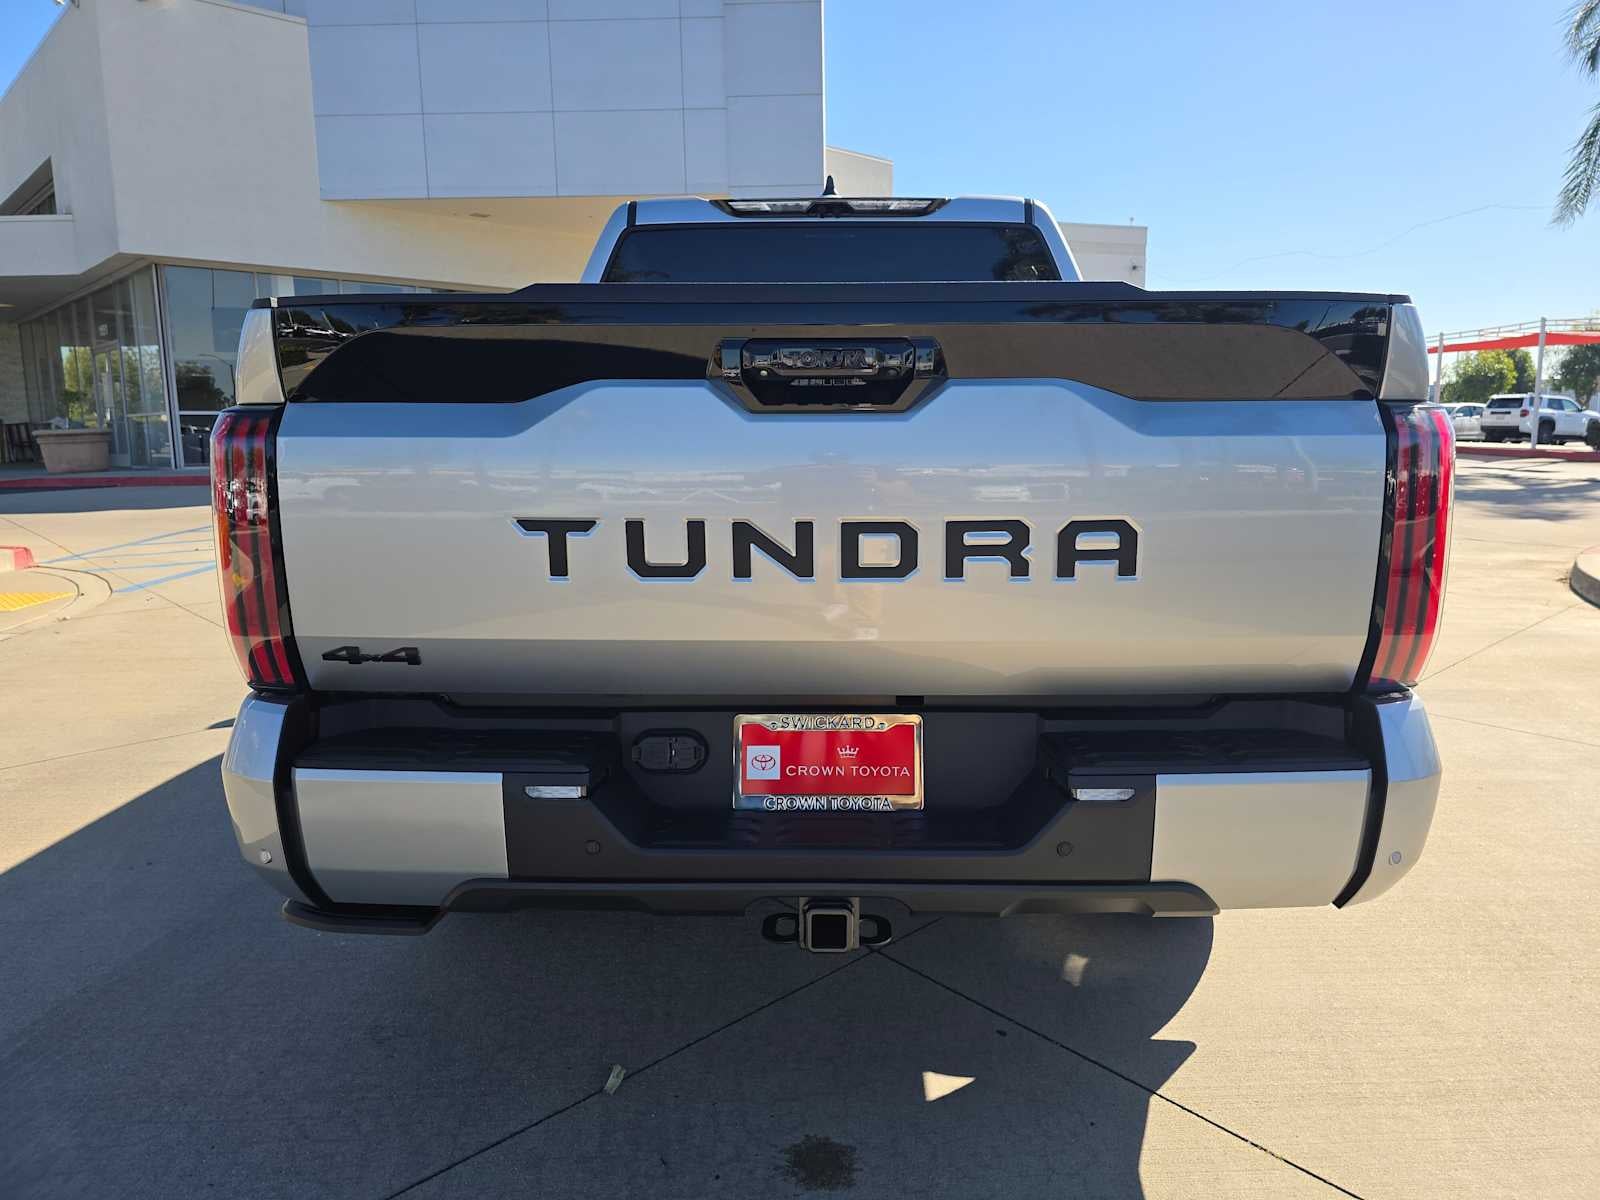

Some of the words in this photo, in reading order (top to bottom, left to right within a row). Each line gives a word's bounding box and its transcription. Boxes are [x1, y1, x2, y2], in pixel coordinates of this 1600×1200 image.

[512, 518, 1140, 581] TUNDRA
[780, 716, 875, 729] SWICKARD
[786, 765, 845, 776] CROWN
[851, 765, 911, 777] TOYOTA
[764, 796, 827, 810] CROWN
[829, 796, 893, 811] TOYOTA
